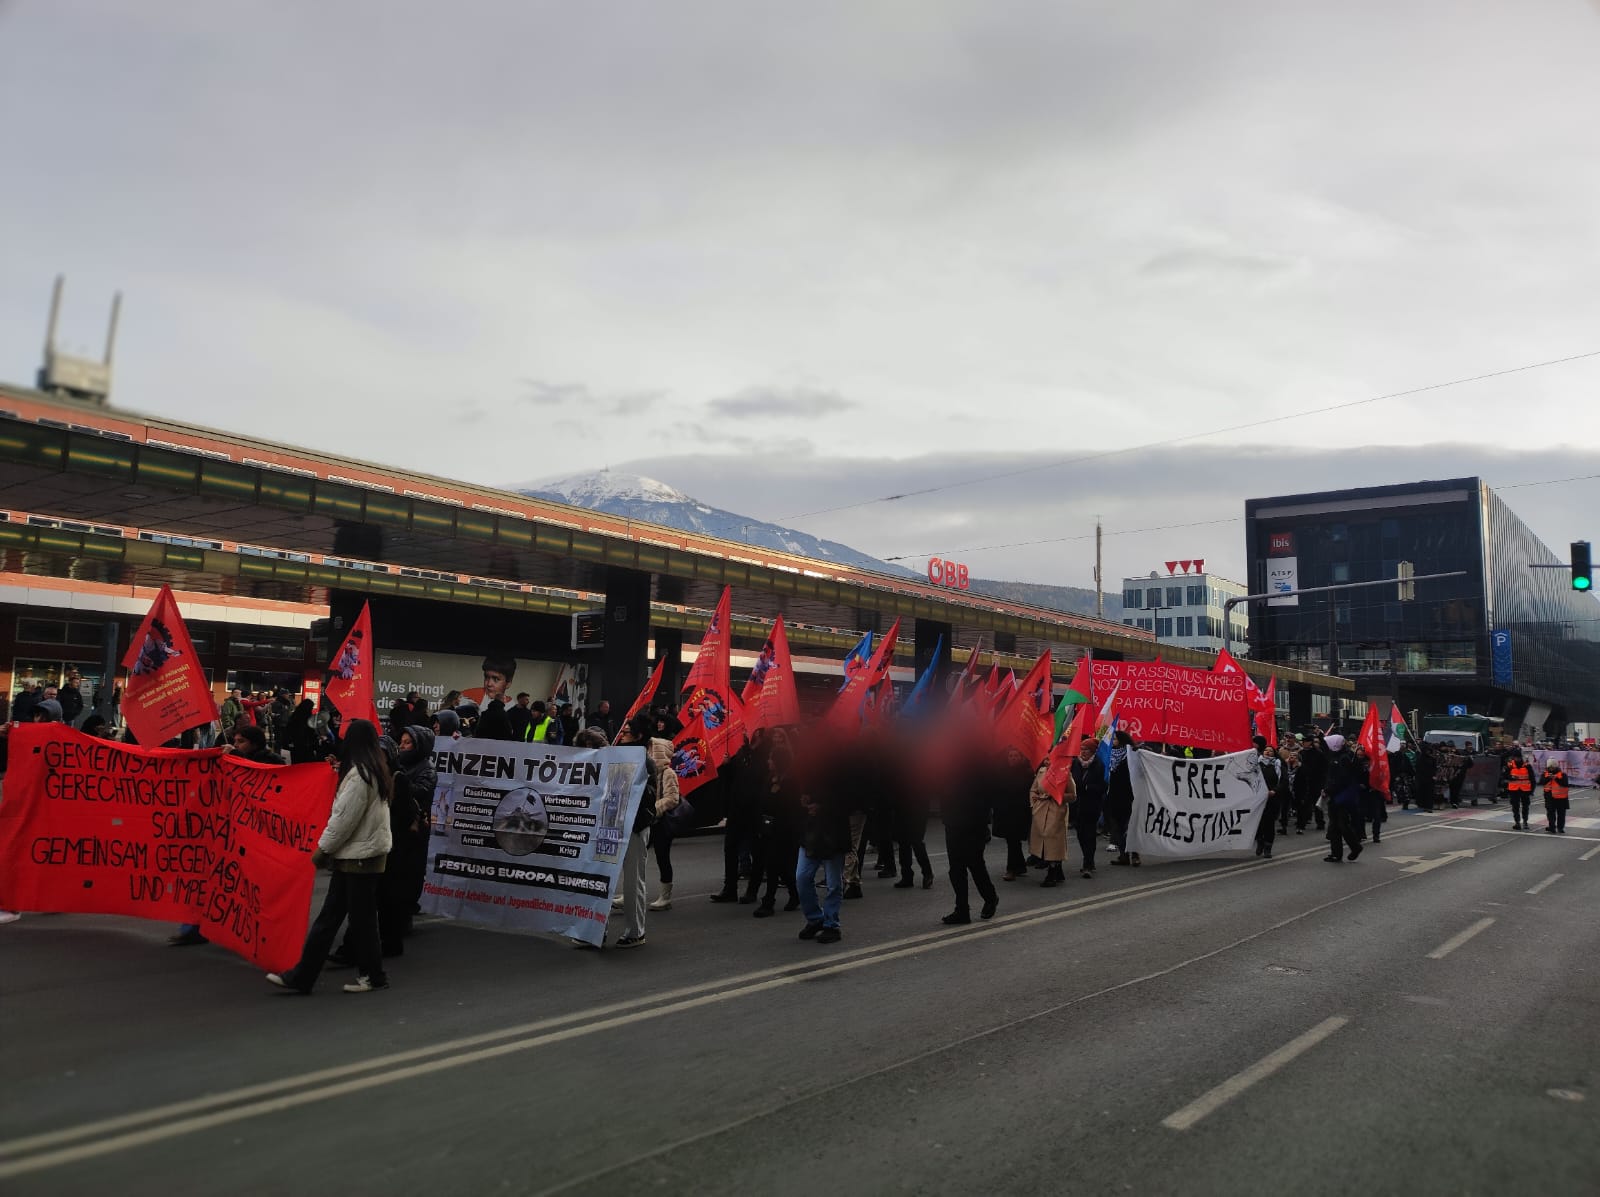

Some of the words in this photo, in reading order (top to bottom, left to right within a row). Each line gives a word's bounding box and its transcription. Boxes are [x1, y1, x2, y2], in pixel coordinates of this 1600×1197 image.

[1273, 538, 1289, 547] ibis
[928, 557, 969, 589] ÖBB
[1496, 635, 1506, 646] P
[1092, 663, 1119, 676] GEN
[1206, 674, 1243, 687] KRIEG
[378, 680, 406, 693] Was
[408, 682, 444, 697] bringt
[1135, 679, 1179, 694] GEGEN
[1180, 684, 1244, 702] SPALTUNG
[1116, 698, 1184, 713] PARKURS!
[524, 755, 602, 785] TÖTEN
[1172, 760, 1226, 799] FREE
[45, 773, 190, 807] GERECHTIGKEIT
[455, 804, 493, 816] Zerstörung
[544, 796, 587, 808] Vertreibung
[1145, 802, 1251, 843] PALESTINE
[31, 836, 148, 869] GEMEINSAM
[462, 836, 484, 846] Armut
[559, 847, 577, 857] Krieg
[439, 859, 495, 876] FESTUNG
[498, 867, 555, 884] EUROPA
[130, 875, 163, 901] UND
